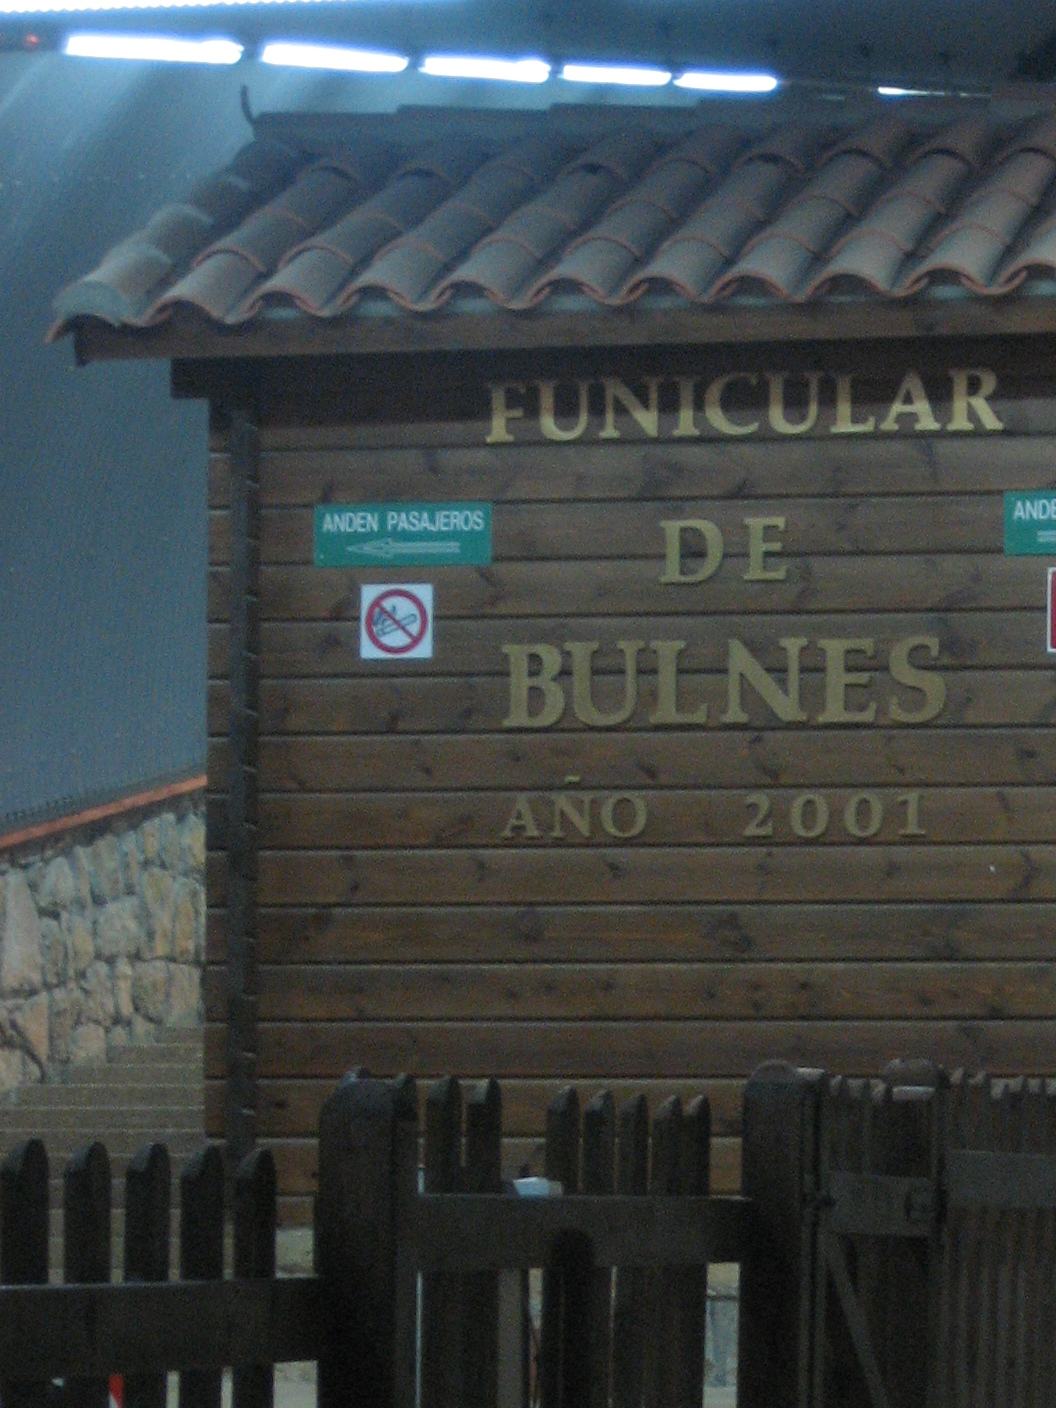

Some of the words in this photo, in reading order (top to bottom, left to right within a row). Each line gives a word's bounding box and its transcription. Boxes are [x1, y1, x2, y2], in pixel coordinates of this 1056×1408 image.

[485, 368, 1003, 445] FUNICULAR
[322, 511, 379, 533] ANDEN
[386, 509, 486, 532] PASAJEROS
[659, 516, 788, 585] DE
[501, 634, 949, 729] BULNES
[502, 776, 649, 840] AÑO
[742, 793, 927, 840] 2001
